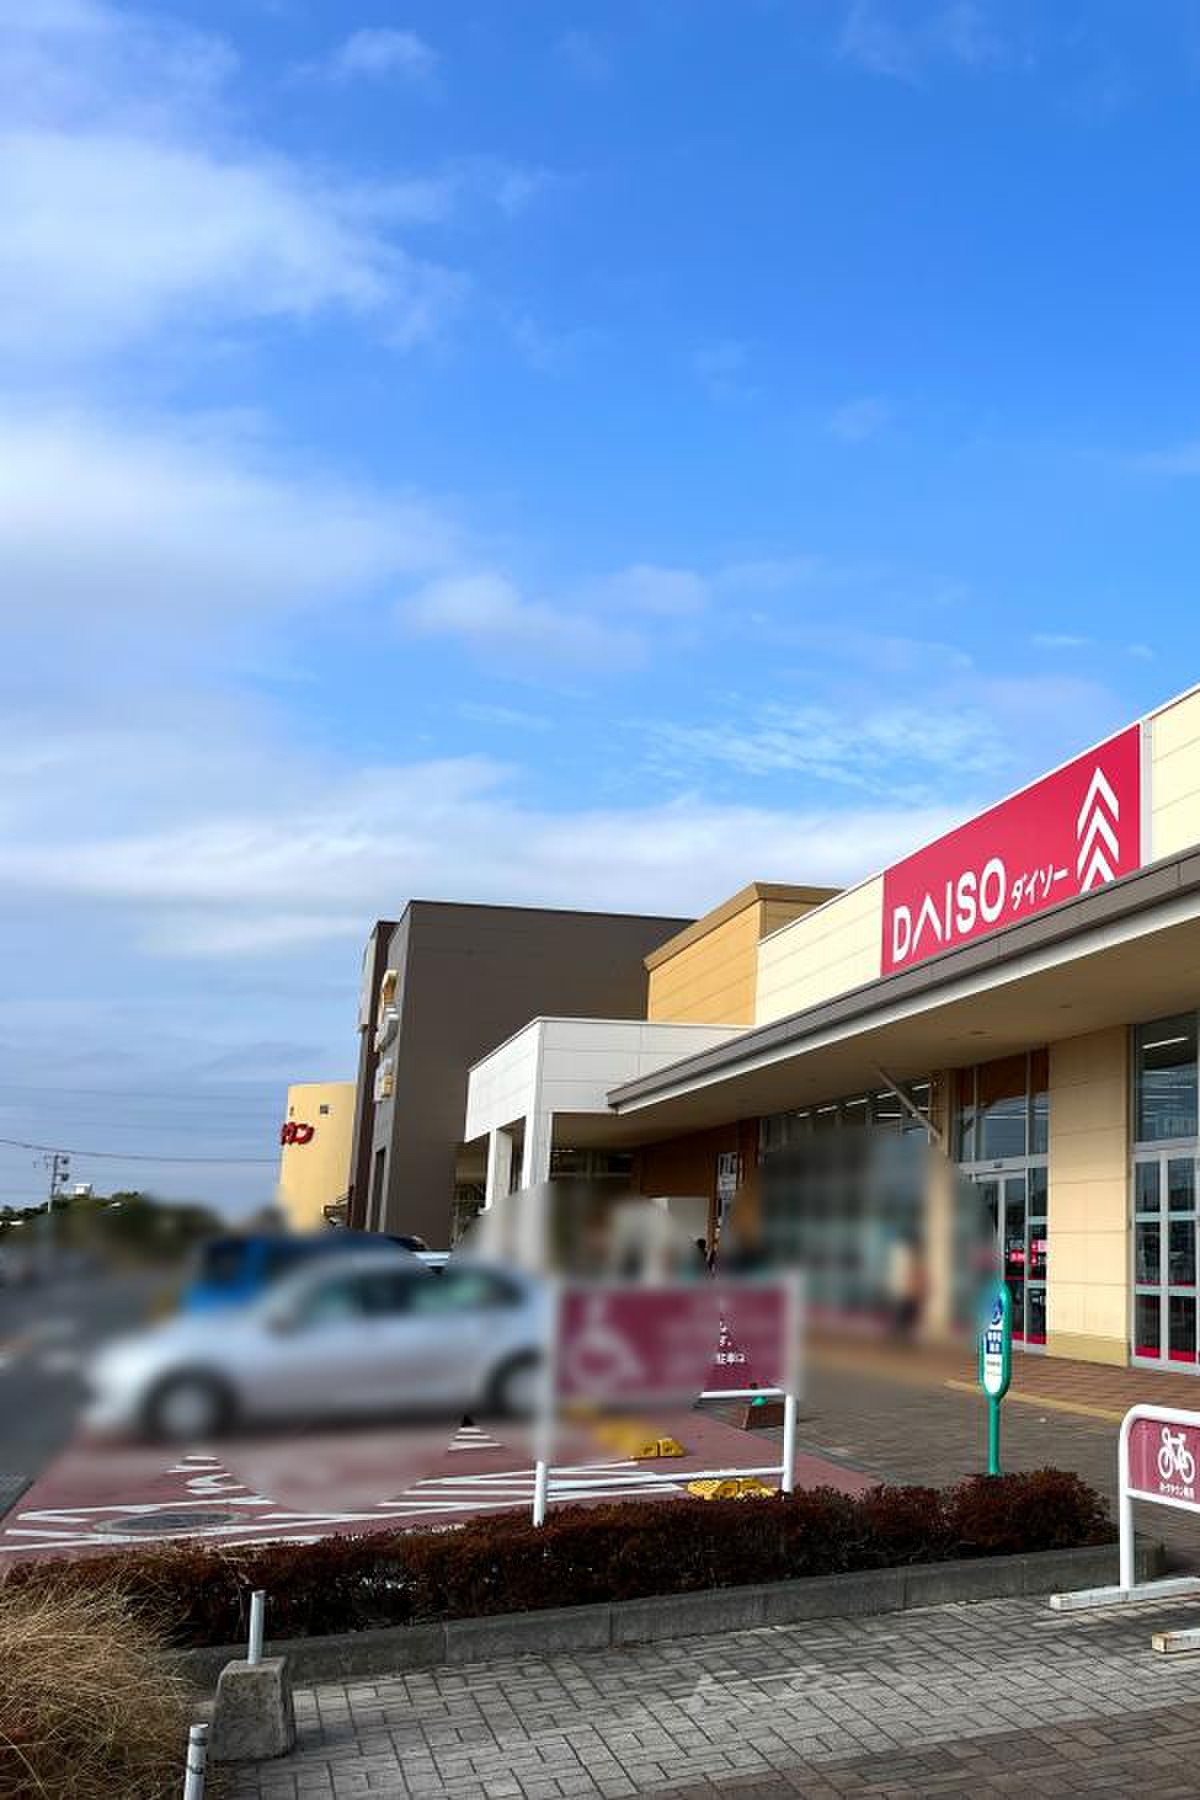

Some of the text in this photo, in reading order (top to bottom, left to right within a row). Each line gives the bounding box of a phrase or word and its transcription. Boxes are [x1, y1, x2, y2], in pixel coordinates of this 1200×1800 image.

[892, 857, 1006, 963] DAISO
[1010, 864, 1068, 910] ダイソー
